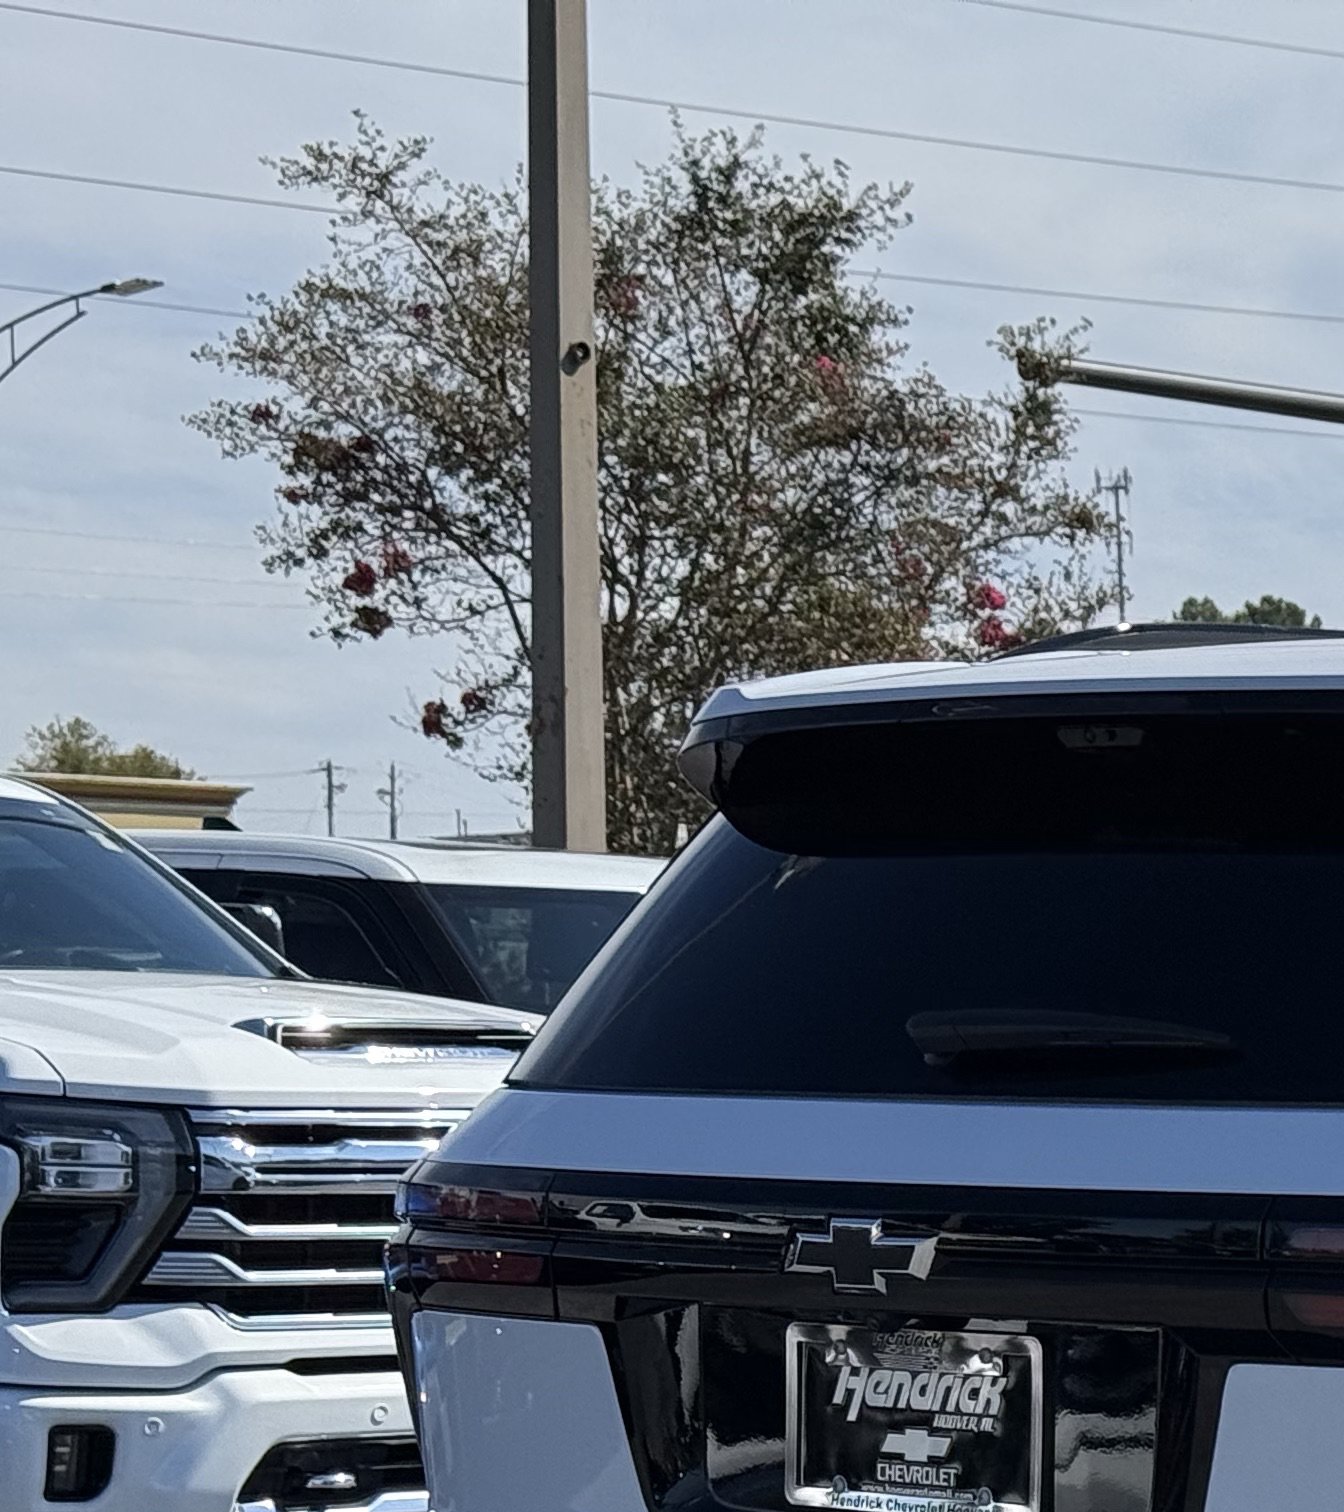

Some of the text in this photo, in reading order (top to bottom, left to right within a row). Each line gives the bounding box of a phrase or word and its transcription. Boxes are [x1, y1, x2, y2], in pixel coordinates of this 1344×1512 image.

[831, 1366, 1007, 1422] Hendrick
[877, 1463, 958, 1487] CHEVROLET
[830, 1493, 882, 1510] Hendrick
